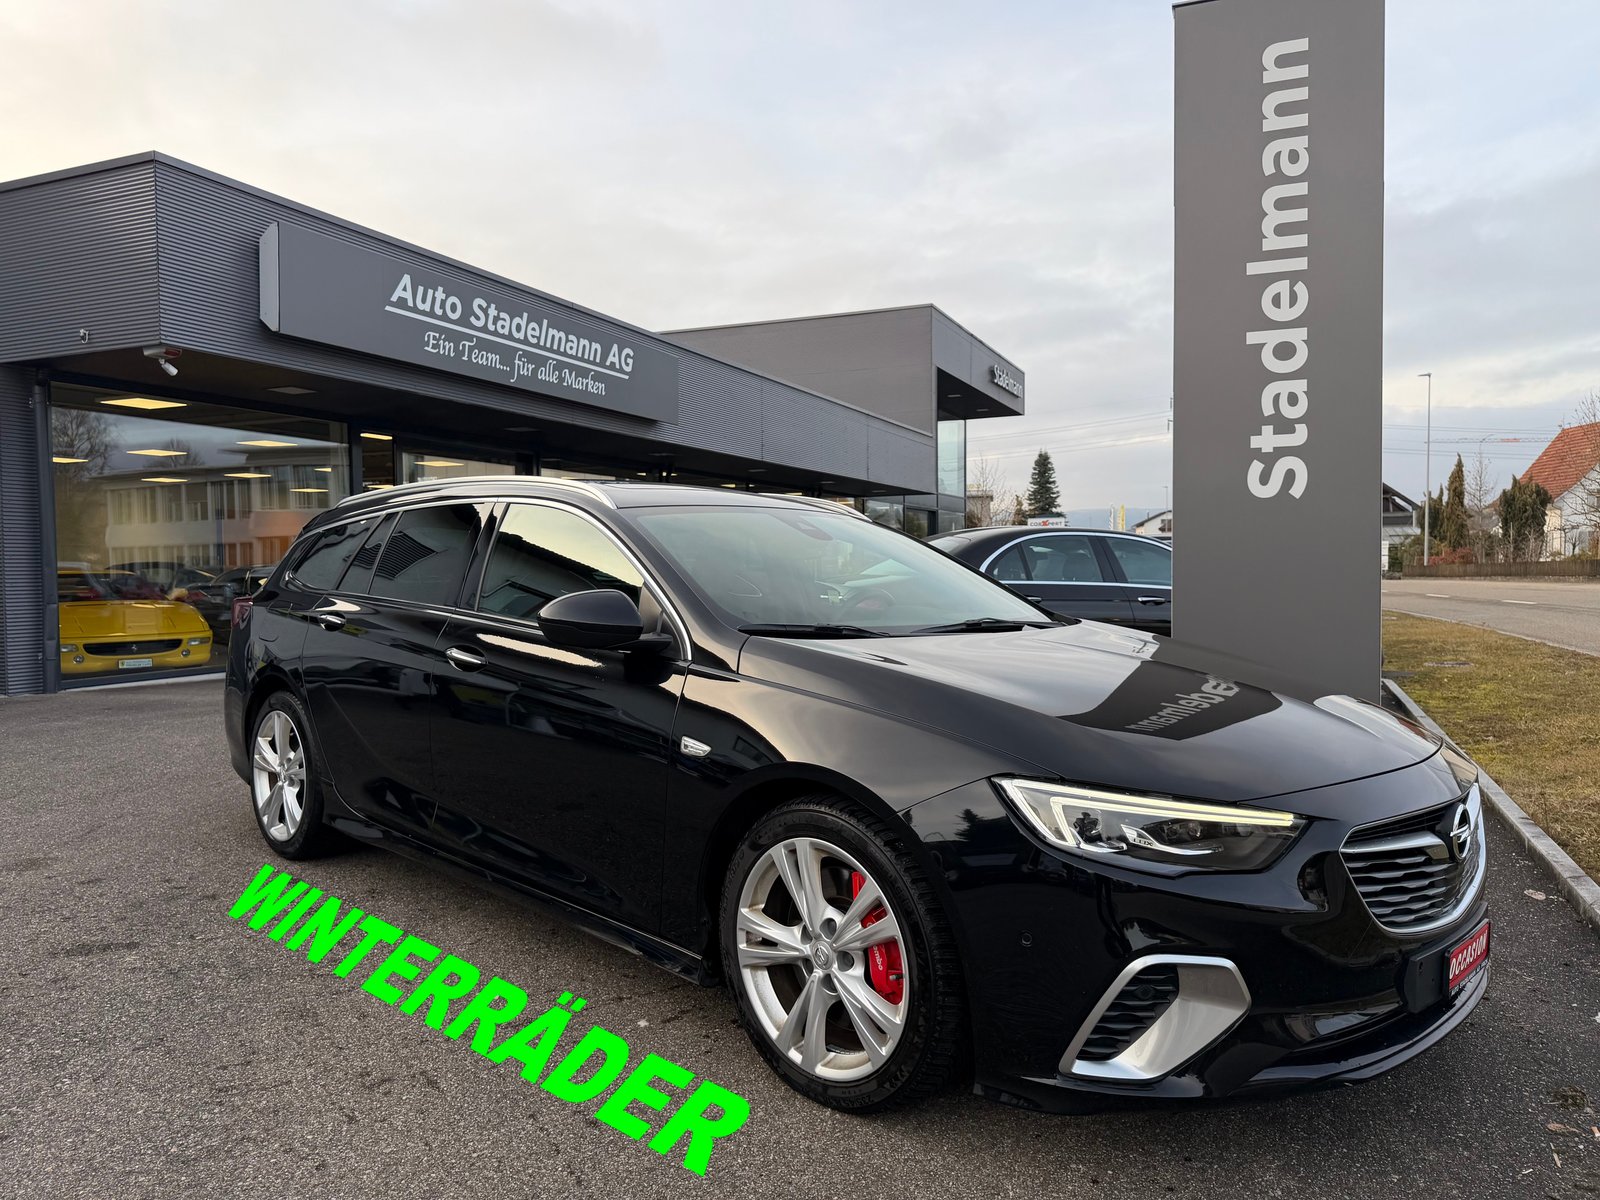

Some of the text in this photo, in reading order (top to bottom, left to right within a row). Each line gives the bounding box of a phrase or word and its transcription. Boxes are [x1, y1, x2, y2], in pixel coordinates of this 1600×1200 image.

[1246, 37, 1309, 499] Stadelmann
[390, 273, 634, 373] Auto Stadelmann AG
[424, 331, 606, 396] Ein Team... für alle Marken
[1449, 929, 1488, 979] OCCASION
